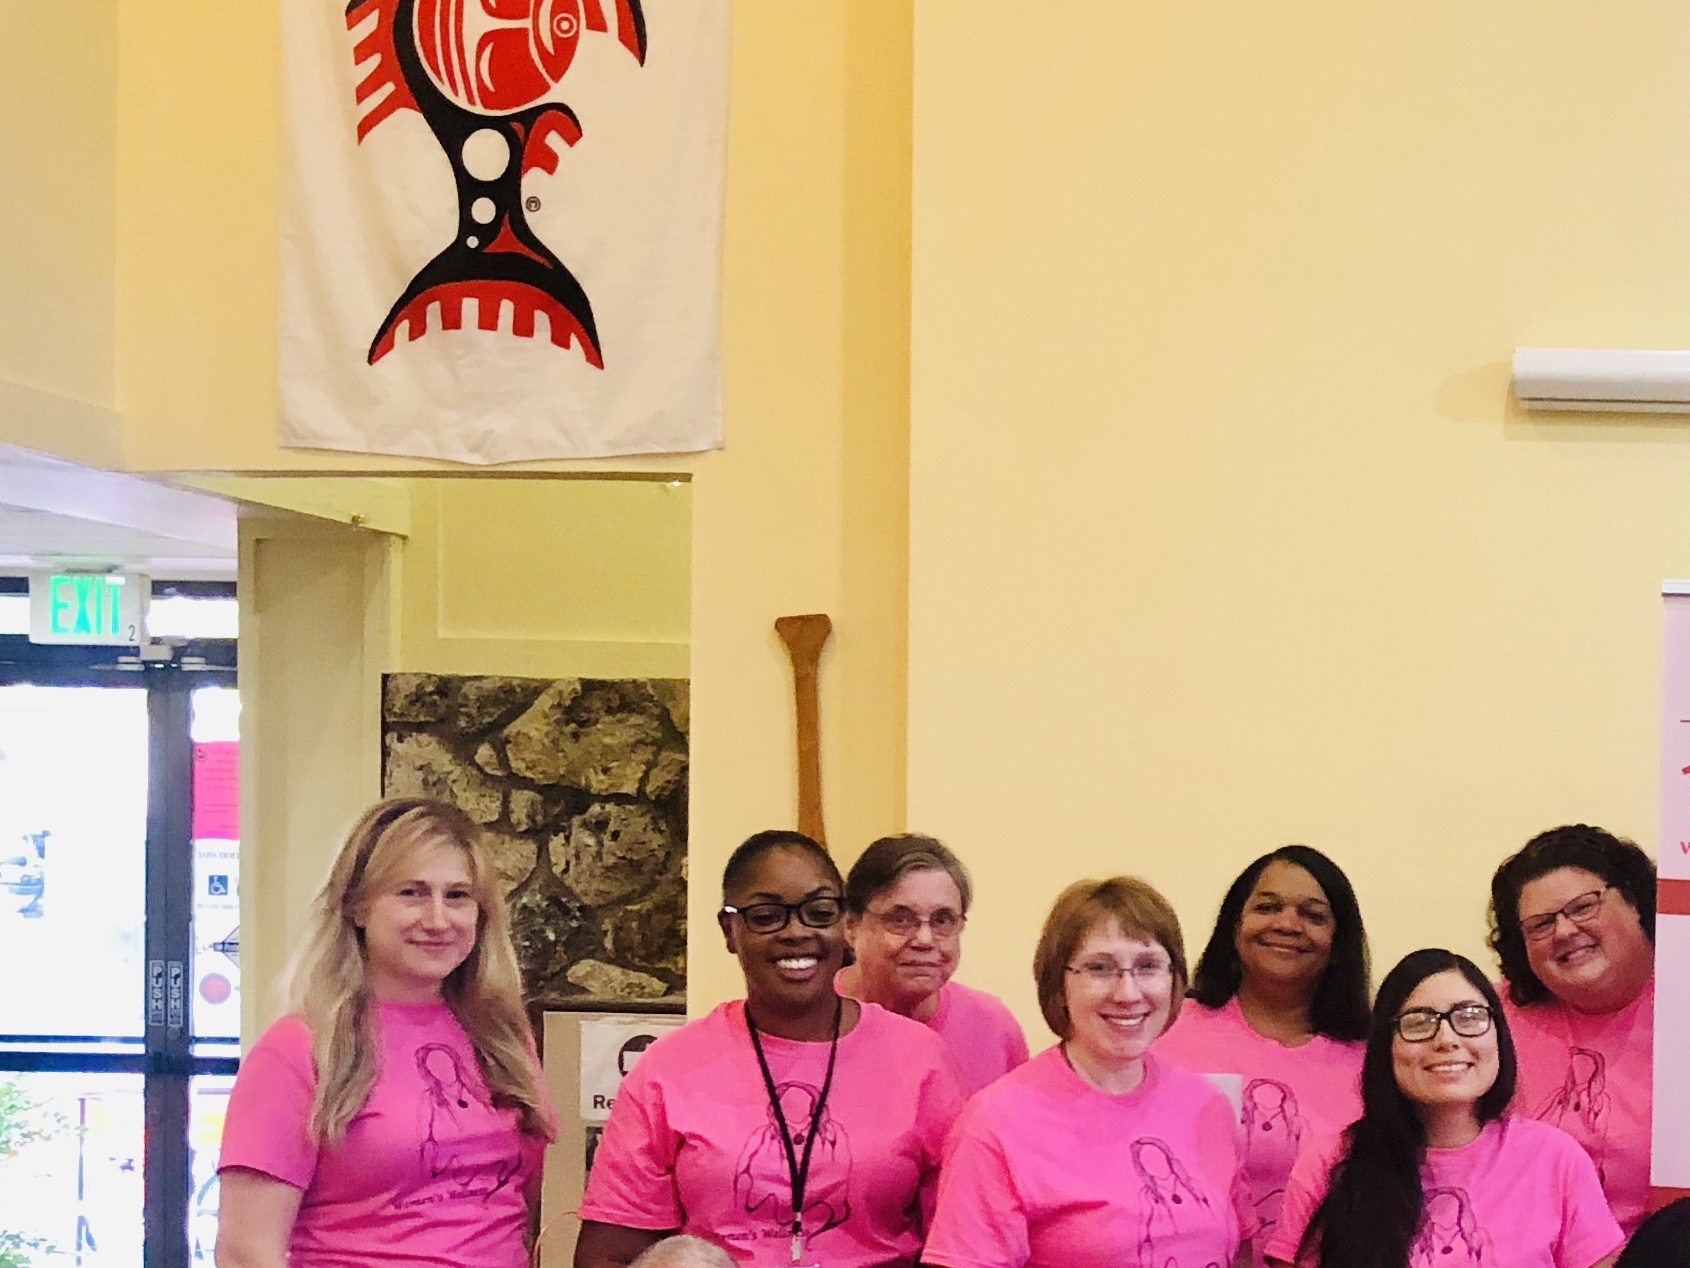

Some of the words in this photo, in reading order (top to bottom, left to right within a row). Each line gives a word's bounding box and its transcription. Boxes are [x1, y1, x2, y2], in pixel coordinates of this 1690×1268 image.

[51, 575, 125, 636] EXIT
[128, 624, 137, 642] 2
[151, 965, 163, 1011] PUSH
[170, 967, 181, 1011] PUSH
